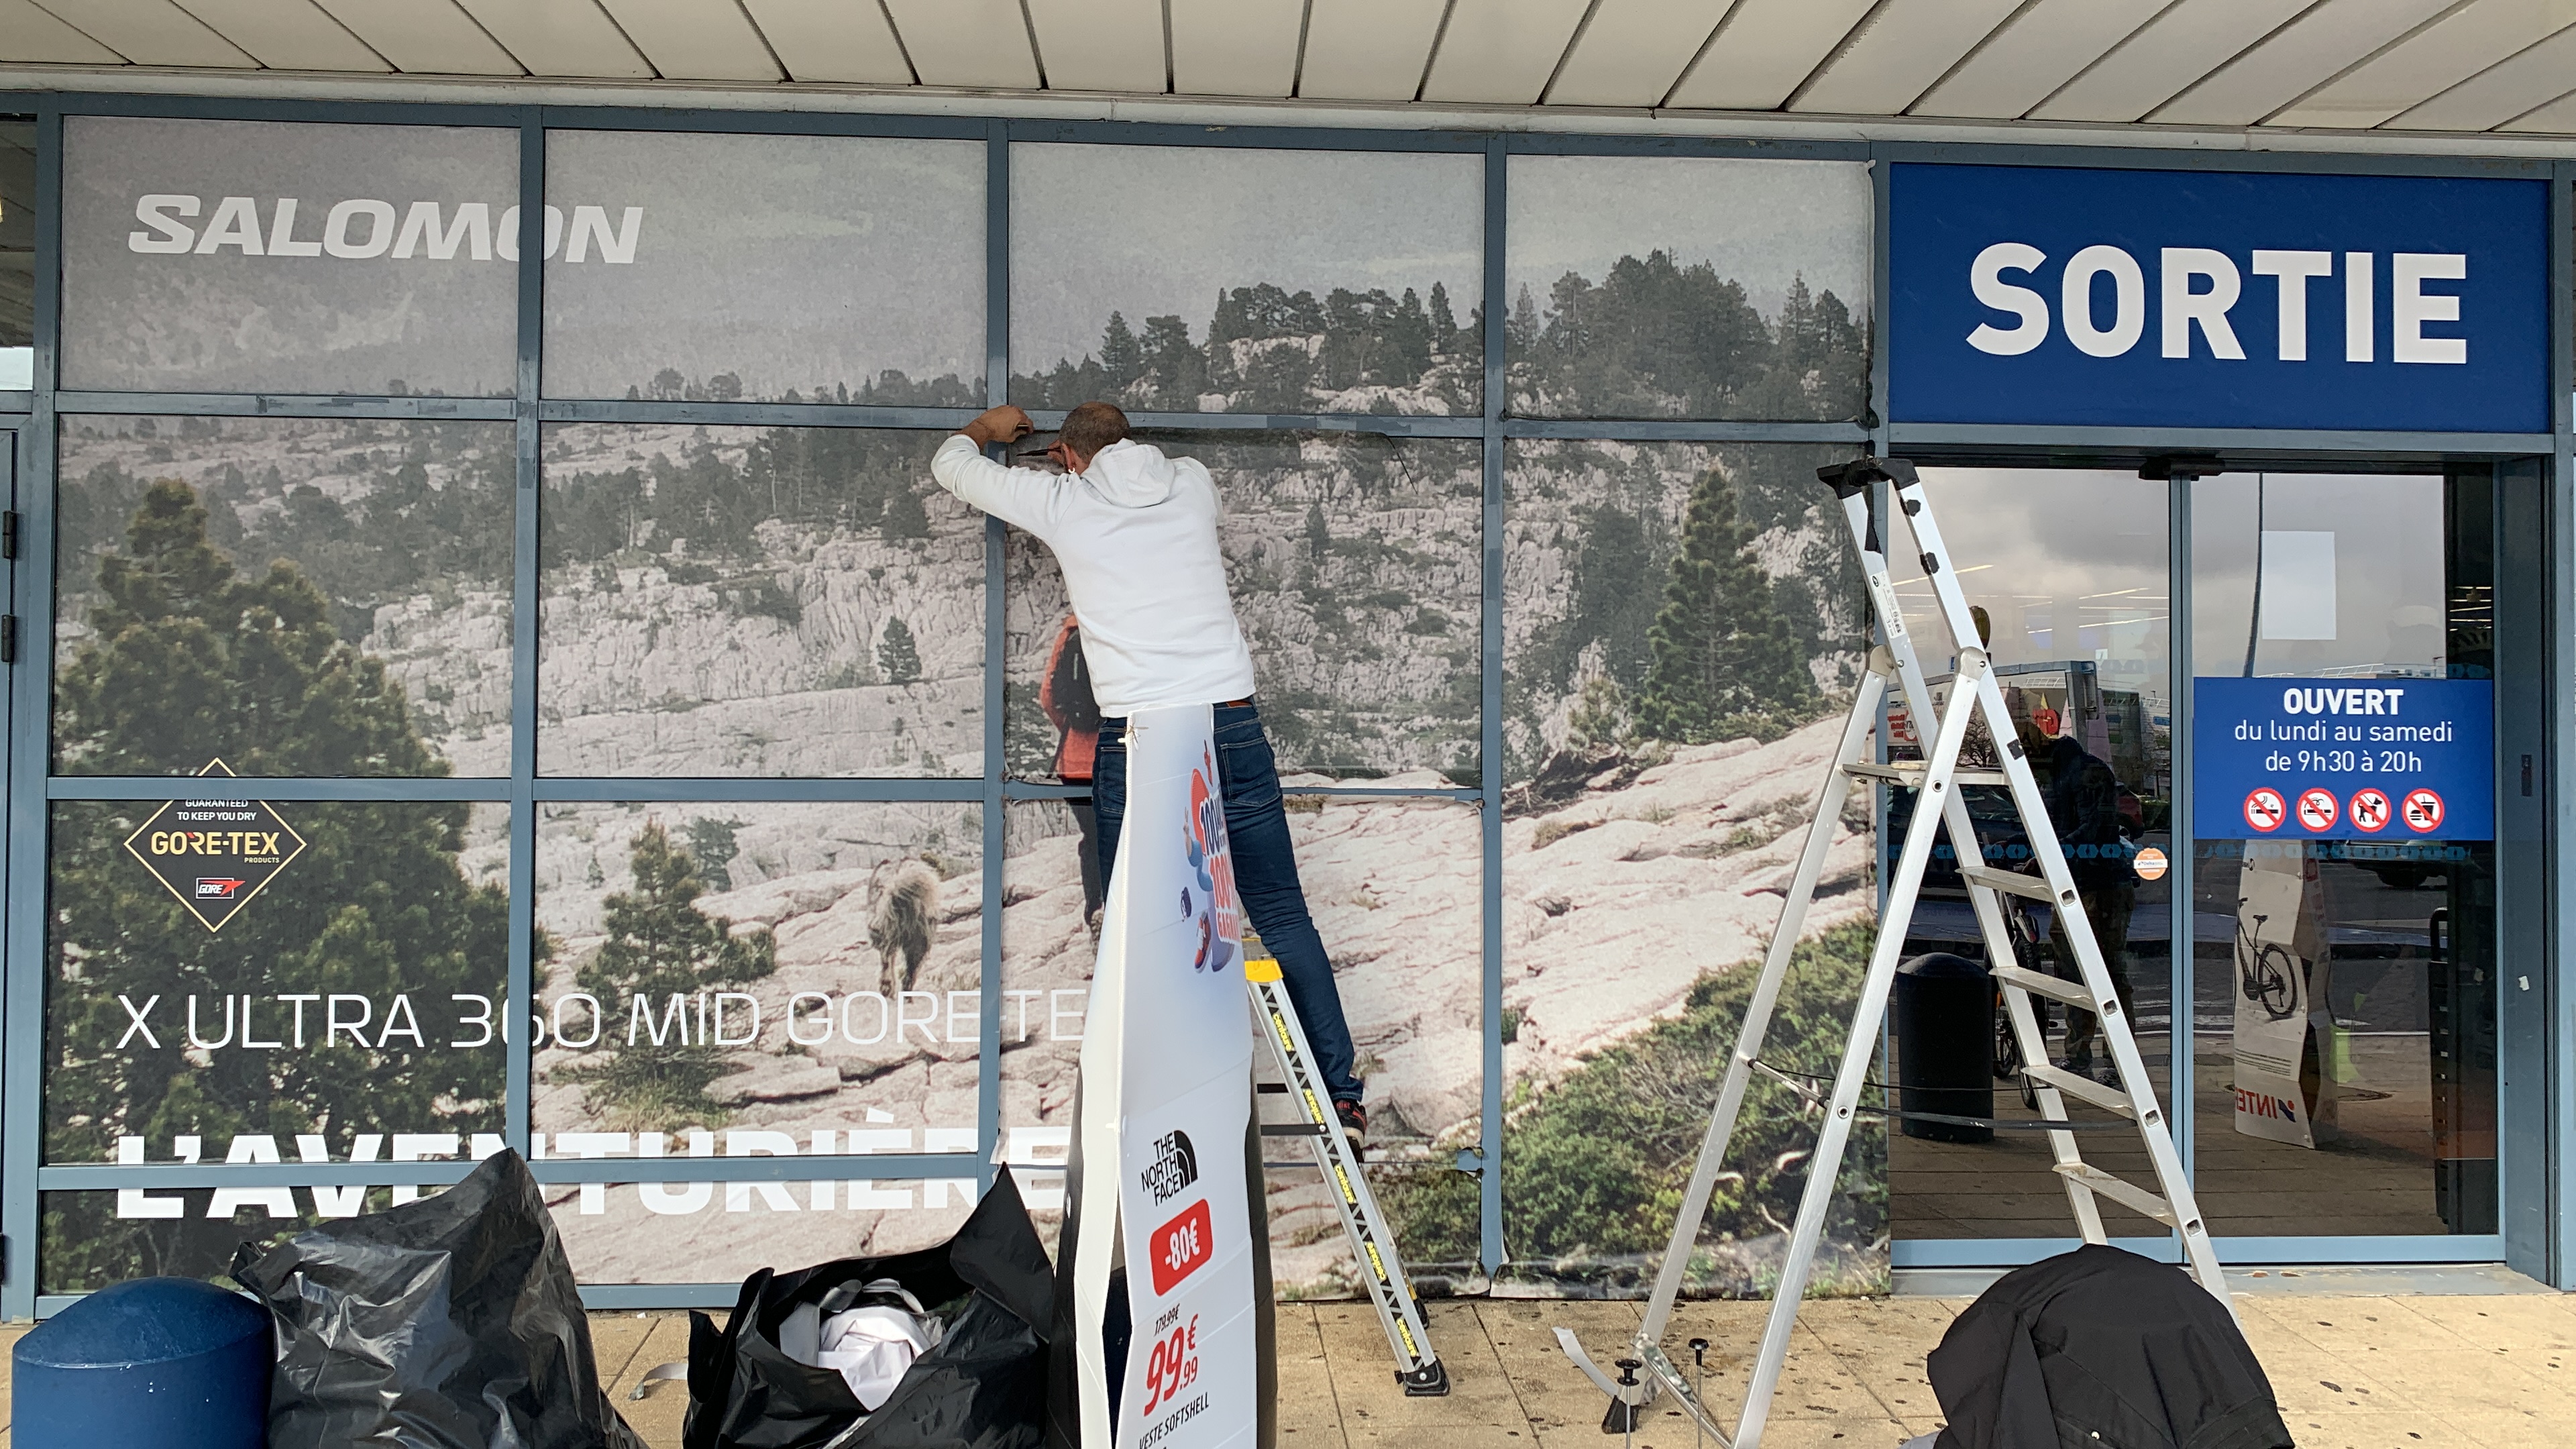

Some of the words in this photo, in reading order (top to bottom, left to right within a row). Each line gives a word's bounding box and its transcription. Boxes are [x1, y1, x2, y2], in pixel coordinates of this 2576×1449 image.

[128, 194, 643, 264] SALOMON
[1966, 242, 2467, 364] SORTIE
[2284, 688, 2404, 715] OUVERT
[2235, 720, 2262, 741] du
[2270, 720, 2326, 742] lundi
[2334, 726, 2361, 742] au
[2369, 721, 2453, 743] samedi
[2265, 750, 2291, 771] de
[2298, 750, 2355, 773] 9h30
[2361, 750, 2374, 772] à
[2380, 751, 2422, 773] 20h
[177, 811, 190, 821] TO
[191, 811, 215, 821] KEEP
[217, 811, 235, 821] YOU
[237, 811, 257, 821] DRY
[185, 799, 249, 808] GUARANTEED
[151, 831, 280, 855] GORE-TEX
[198, 884, 223, 894] GORE
[116, 994, 161, 1050] X
[187, 994, 425, 1050] ULTRA
[627, 992, 760, 1046] MID
[787, 989, 1087, 1044] GORETE
[1273, 1013, 1293, 1052] centaure
[1153, 1132, 1175, 1160] THE
[1141, 1152, 1177, 1192] NORTH
[1154, 1174, 1180, 1207] FACE
[1334, 1165, 1354, 1203] centaure
[1165, 1217, 1200, 1271] -80€
[1366, 1242, 1387, 1281] centaure
[1397, 1318, 1417, 1356] centaure
[1140, 1421, 1163, 1449] VESTE
[1164, 1391, 1210, 1436] SOFTSHELL
